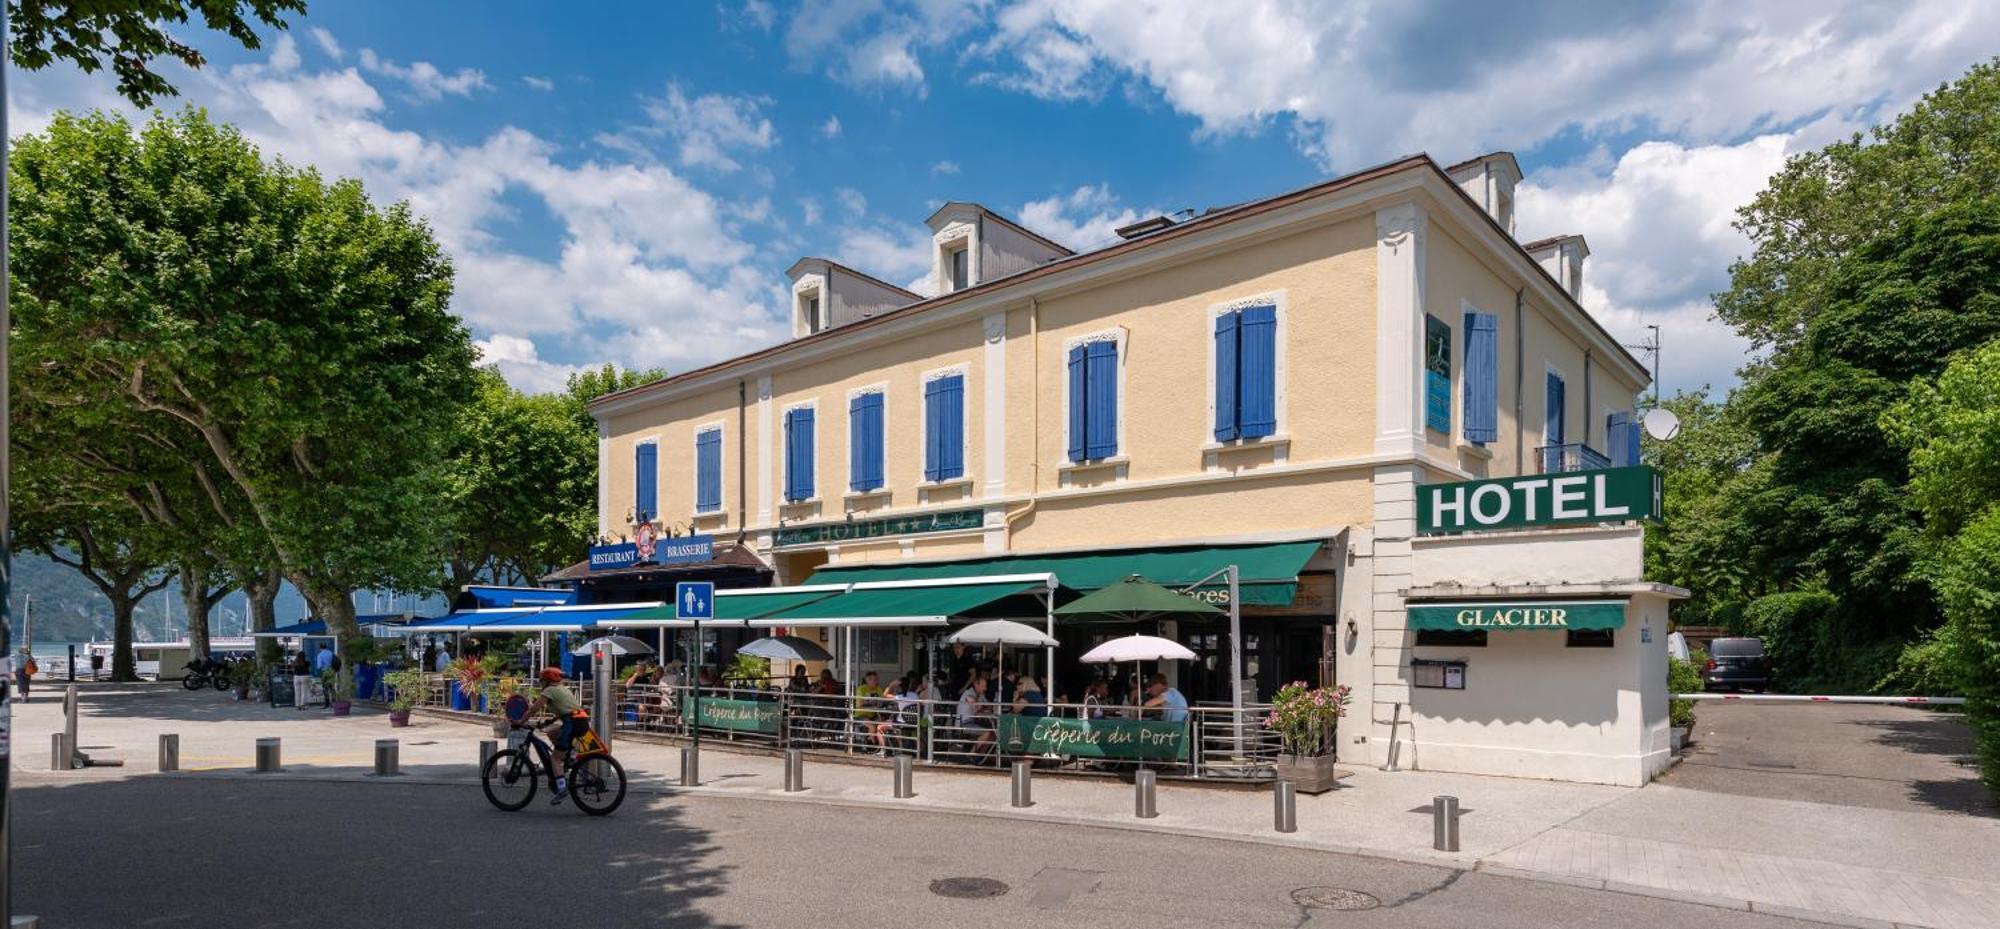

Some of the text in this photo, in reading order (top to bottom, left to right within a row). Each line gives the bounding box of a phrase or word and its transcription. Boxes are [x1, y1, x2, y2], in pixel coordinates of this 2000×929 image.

[1432, 474, 1630, 528] HOTEL
[819, 519, 894, 541] HOTEL
[591, 543, 710, 565] RESTAURANT BRASSERIE
[1456, 608, 1568, 627] GLACIER
[1032, 719, 1181, 751] Crêperie du Port
